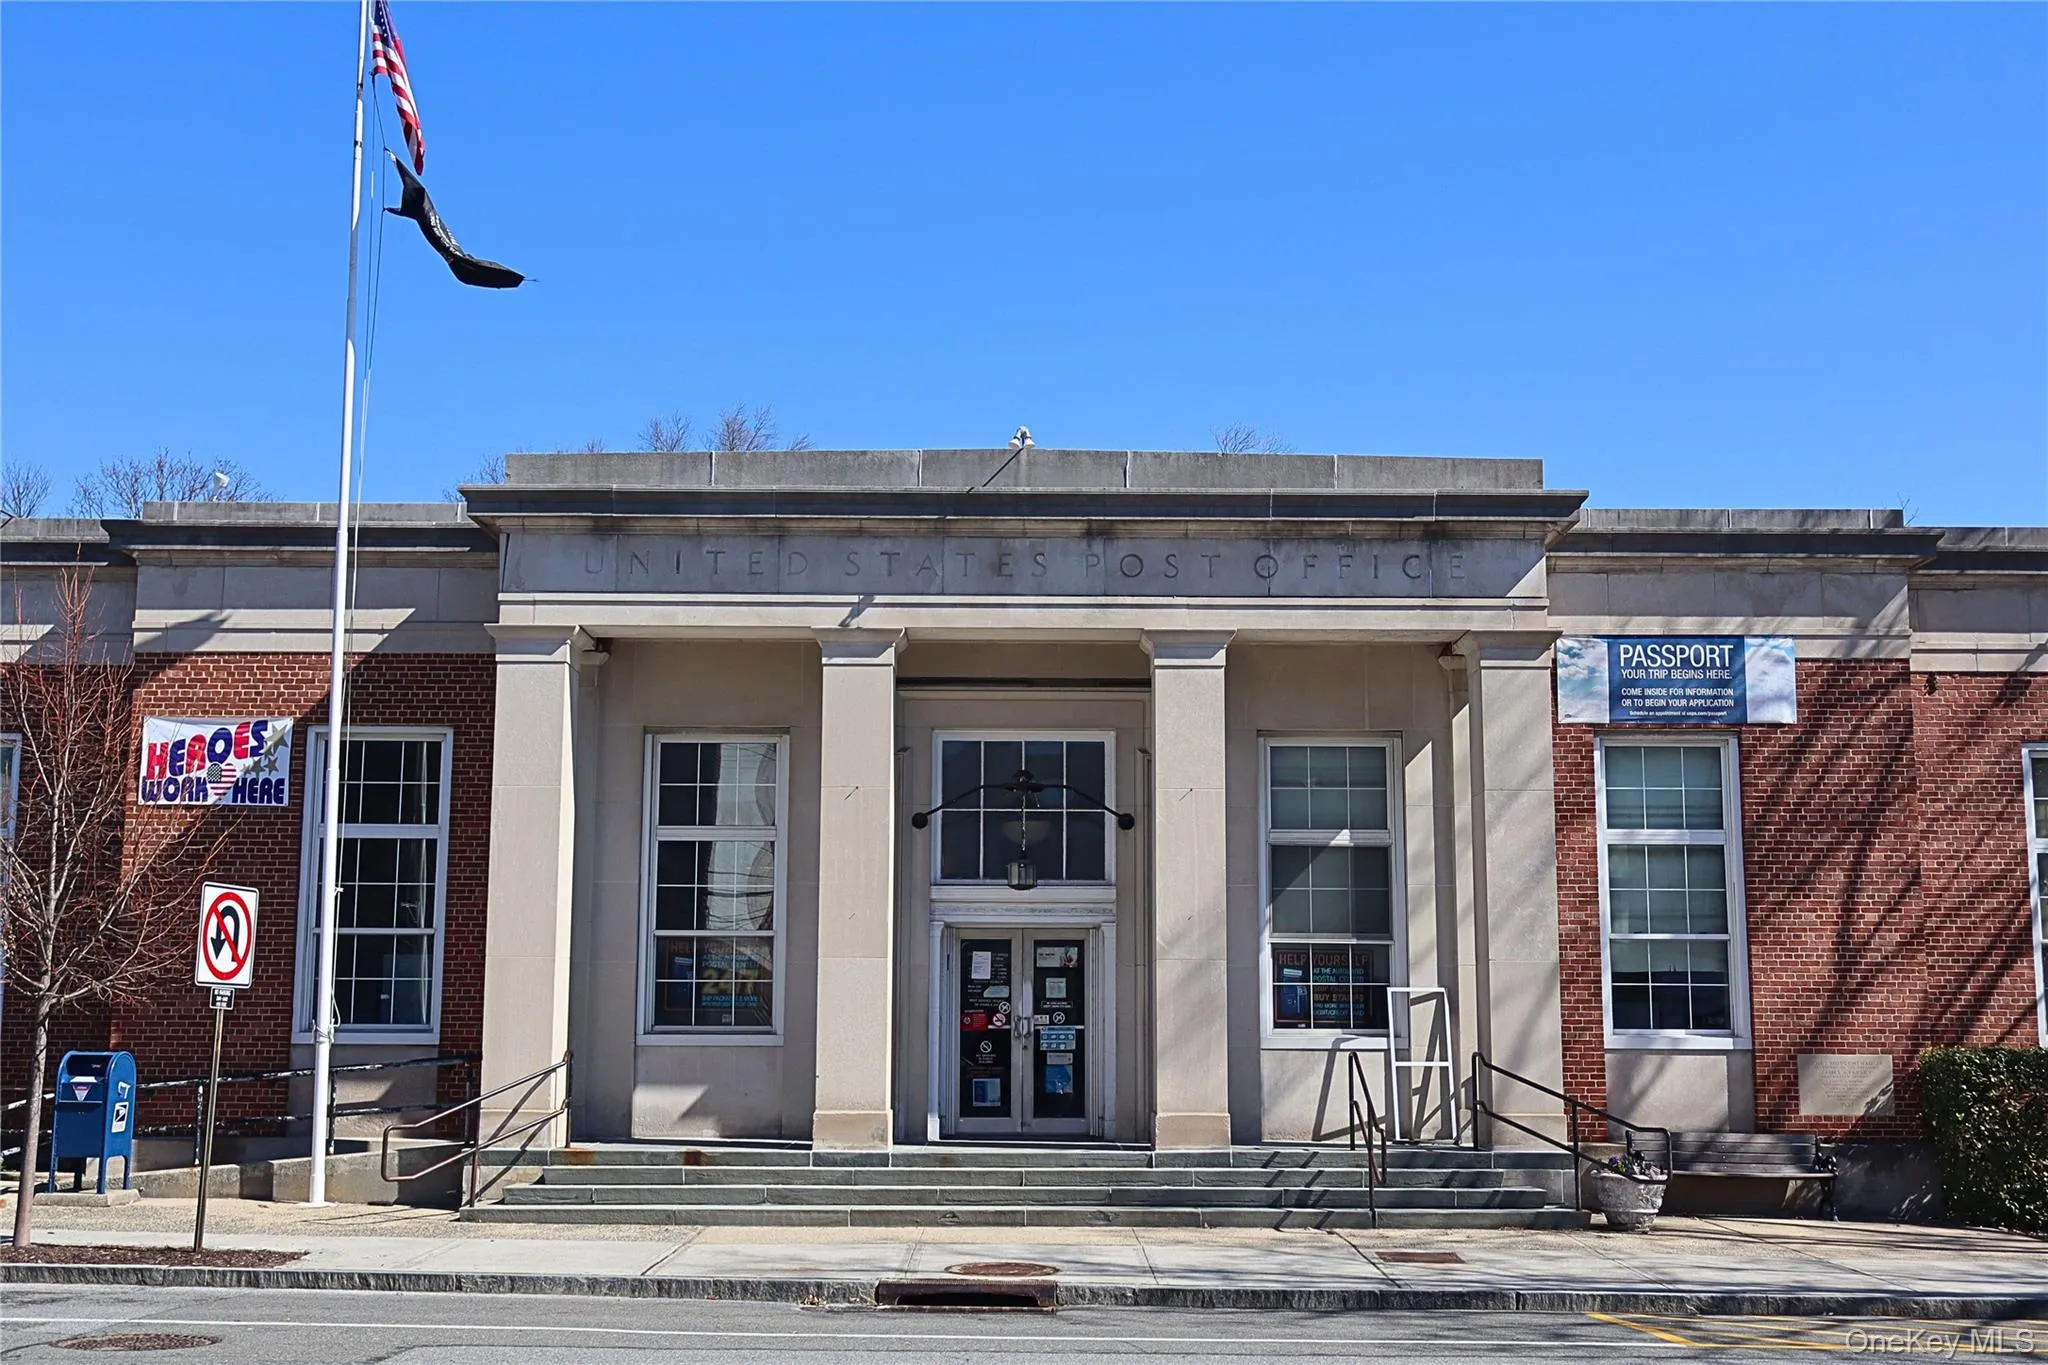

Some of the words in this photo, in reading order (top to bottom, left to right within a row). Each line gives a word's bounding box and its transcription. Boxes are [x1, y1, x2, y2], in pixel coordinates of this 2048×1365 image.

[584, 551, 809, 576] UNITED
[844, 552, 1049, 578] STATES
[1085, 553, 1221, 579] POST
[1254, 554, 1466, 580] OFFICE
[1619, 644, 1734, 668] PASSPORT
[1621, 669, 1646, 680] YOUR
[1648, 669, 1669, 680] TRIP
[1670, 669, 1704, 680] BEGINS
[1706, 669, 1733, 680] HERE.
[1621, 687, 1643, 696] COME
[1644, 687, 1668, 696] INSIDE
[1669, 687, 1684, 696] FOR
[1685, 687, 1734, 696] INFORMATION
[1621, 698, 1632, 707] OR
[1634, 698, 1644, 707] TO
[1645, 698, 1667, 707] BEGIN
[1668, 698, 1688, 707] YOUR
[1689, 698, 1735, 707] APPLICATION
[146, 719, 269, 781] HEROES
[141, 775, 209, 803] WORK
[231, 777, 286, 805] HERE
[1279, 952, 1308, 966] HELP
[1314, 953, 1368, 966] YOURSLF
